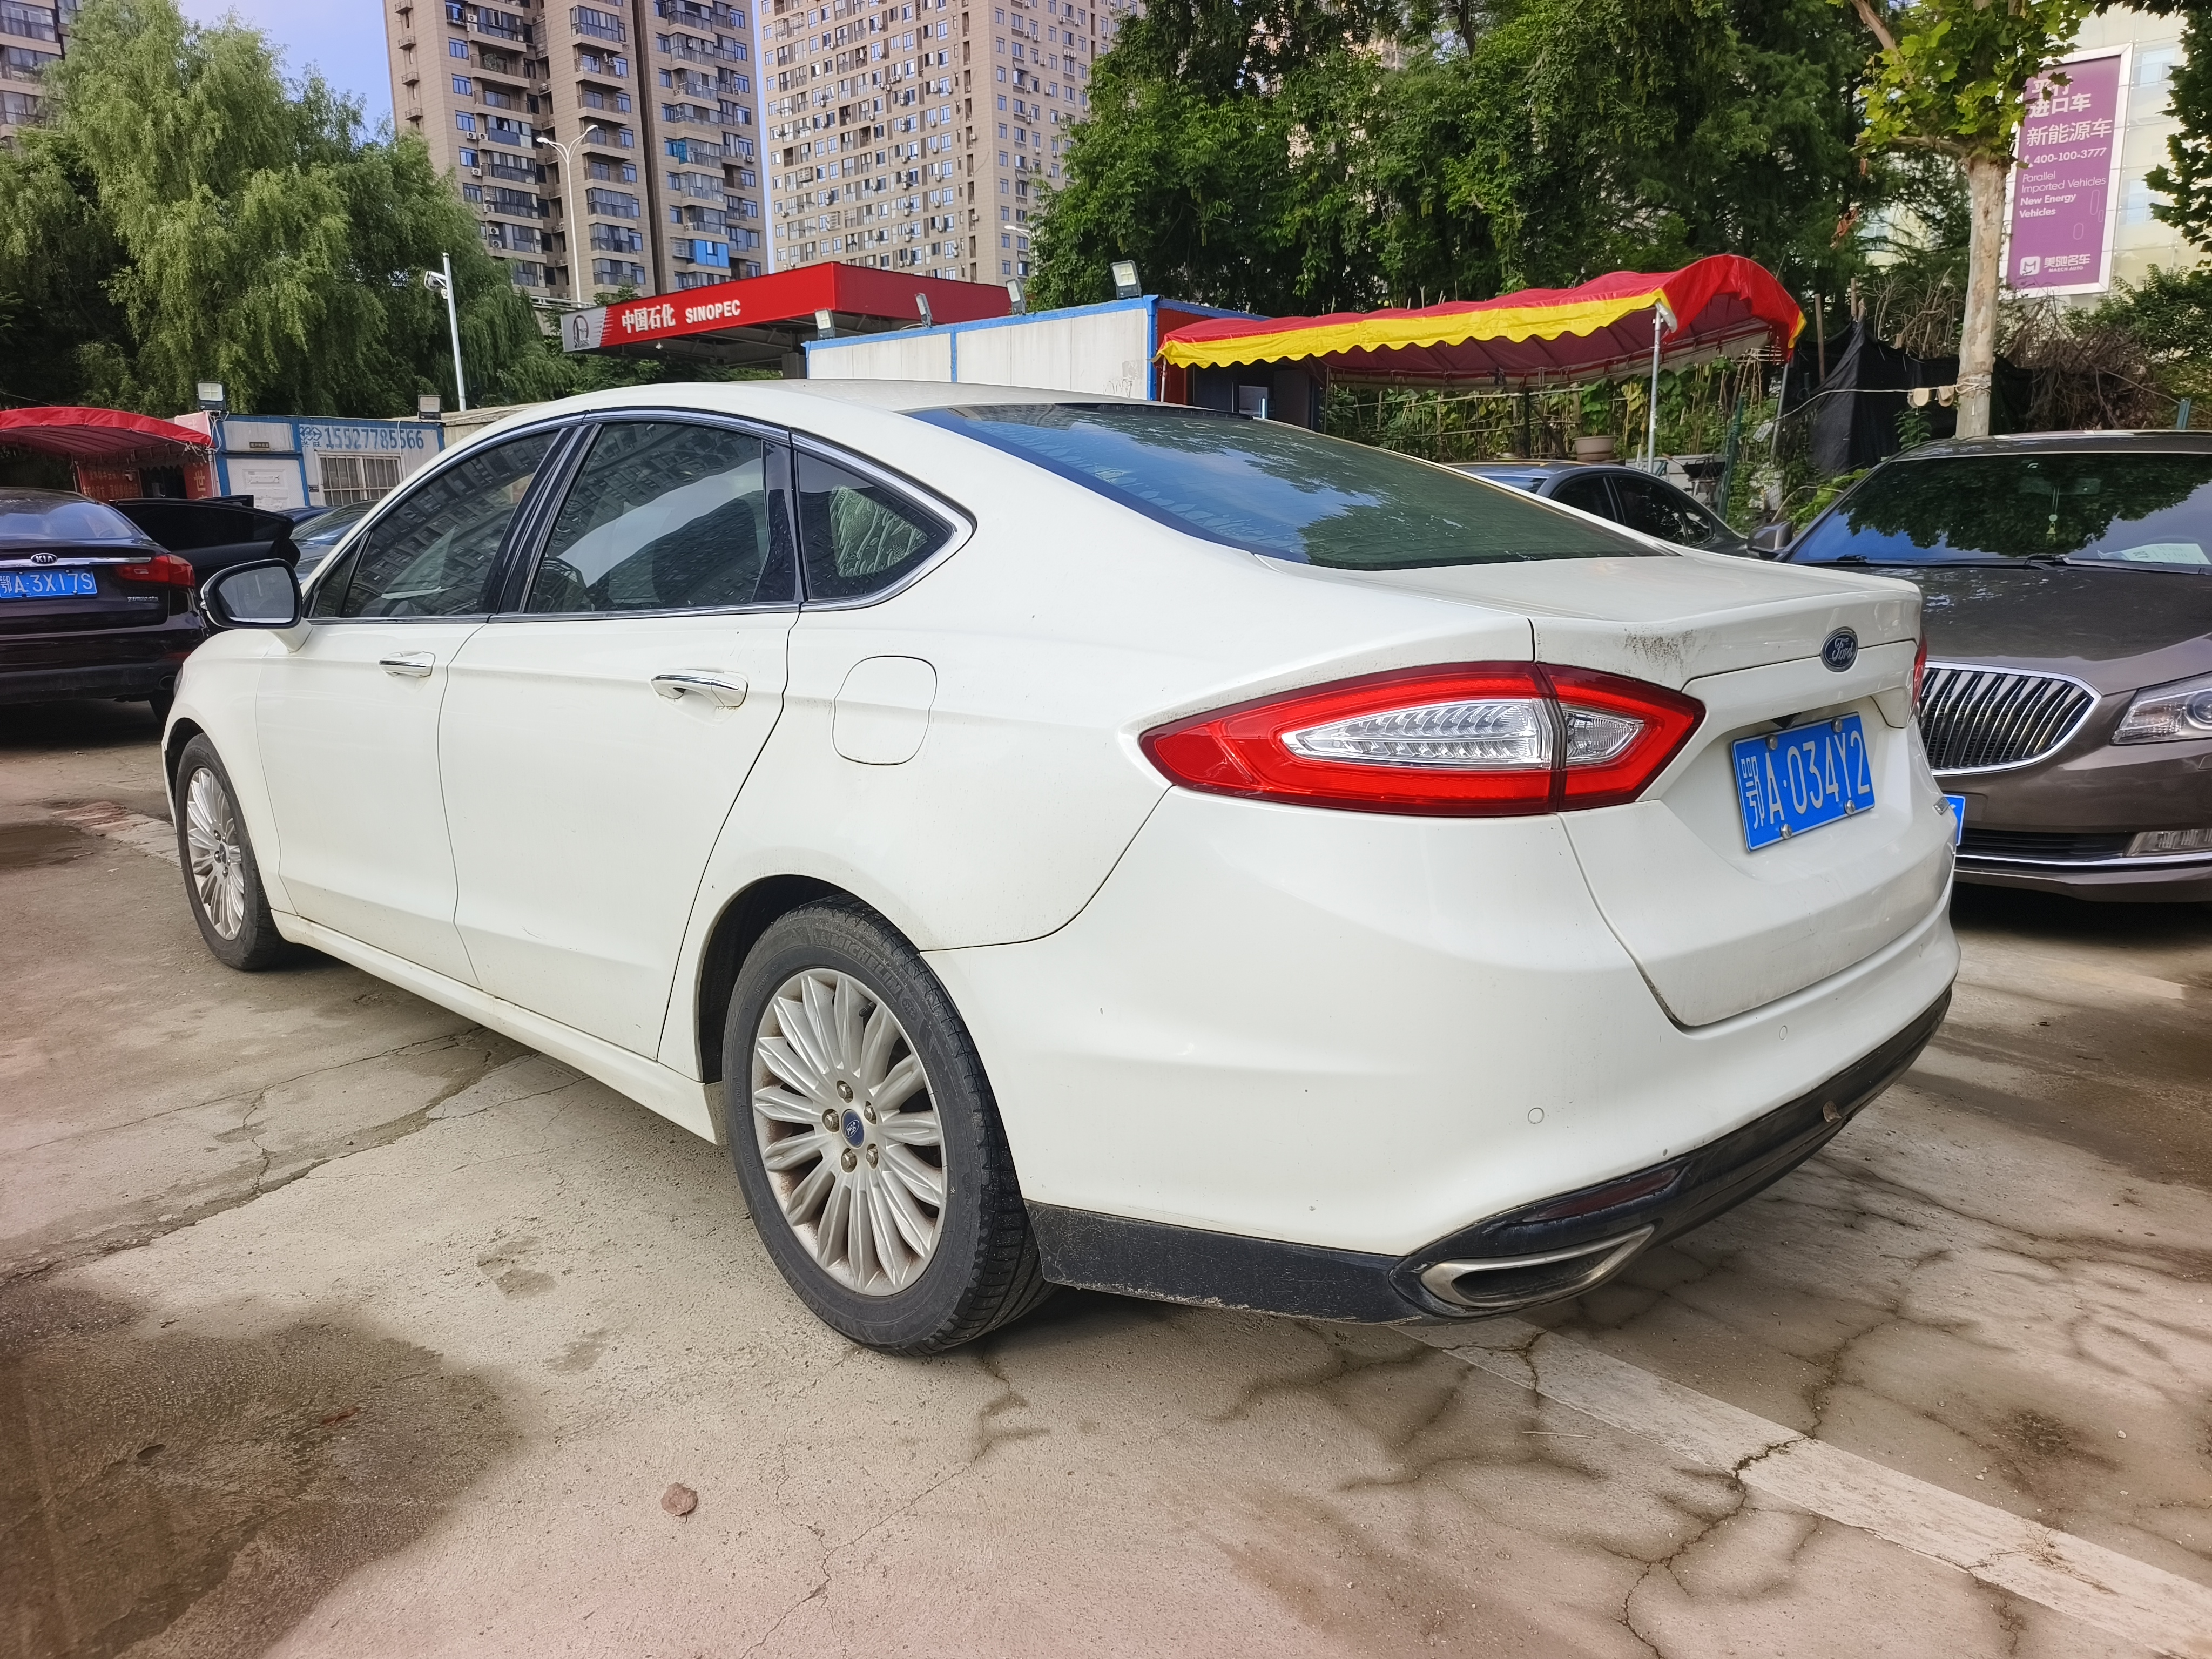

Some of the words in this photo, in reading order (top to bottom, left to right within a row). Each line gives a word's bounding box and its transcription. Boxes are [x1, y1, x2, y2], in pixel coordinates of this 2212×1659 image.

[2029, 93, 2092, 118] 进口车
[2027, 118, 2113, 147] 新能源车
[2034, 147, 2107, 164] 400-100-3777
[2021, 180, 2065, 194] Imported
[2067, 176, 2106, 188] Vehicles
[2022, 170, 2056, 183] Parallel
[2020, 197, 2042, 206] New
[2044, 194, 2076, 204] Energy
[2019, 207, 2056, 218] Vehicles
[2044, 254, 2091, 268] 美驰名车
[622, 303, 676, 334] 中国石化
[685, 299, 741, 324] SINOPEC
[324, 426, 424, 450] 15527785566
[1832, 637, 1854, 662] Ford
[830, 933, 903, 995] MICHELIN
